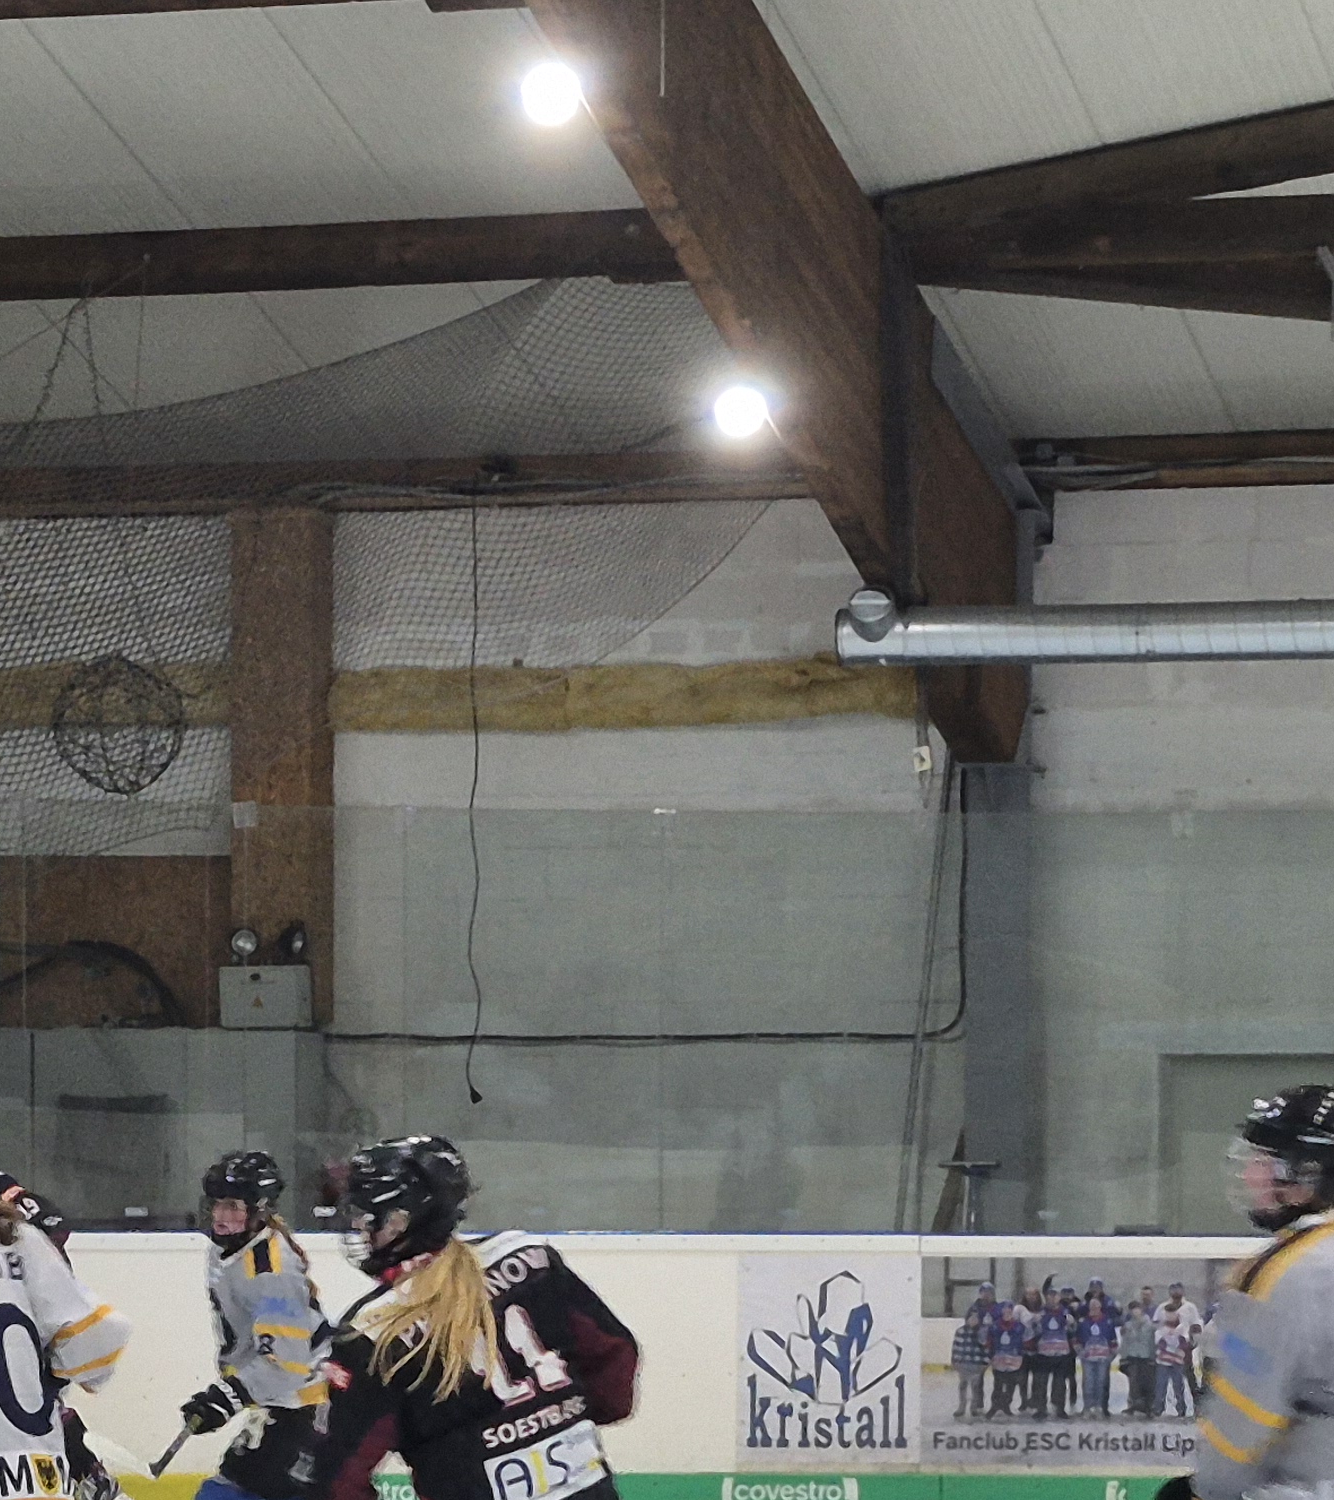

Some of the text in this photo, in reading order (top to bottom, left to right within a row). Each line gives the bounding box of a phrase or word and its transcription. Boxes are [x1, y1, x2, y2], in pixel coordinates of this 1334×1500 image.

[746, 1373, 908, 1449] kristall
[932, 1431, 1018, 1451] Fanclub
[1026, 1432, 1071, 1451] ESC
[1078, 1432, 1156, 1452] Kristall
